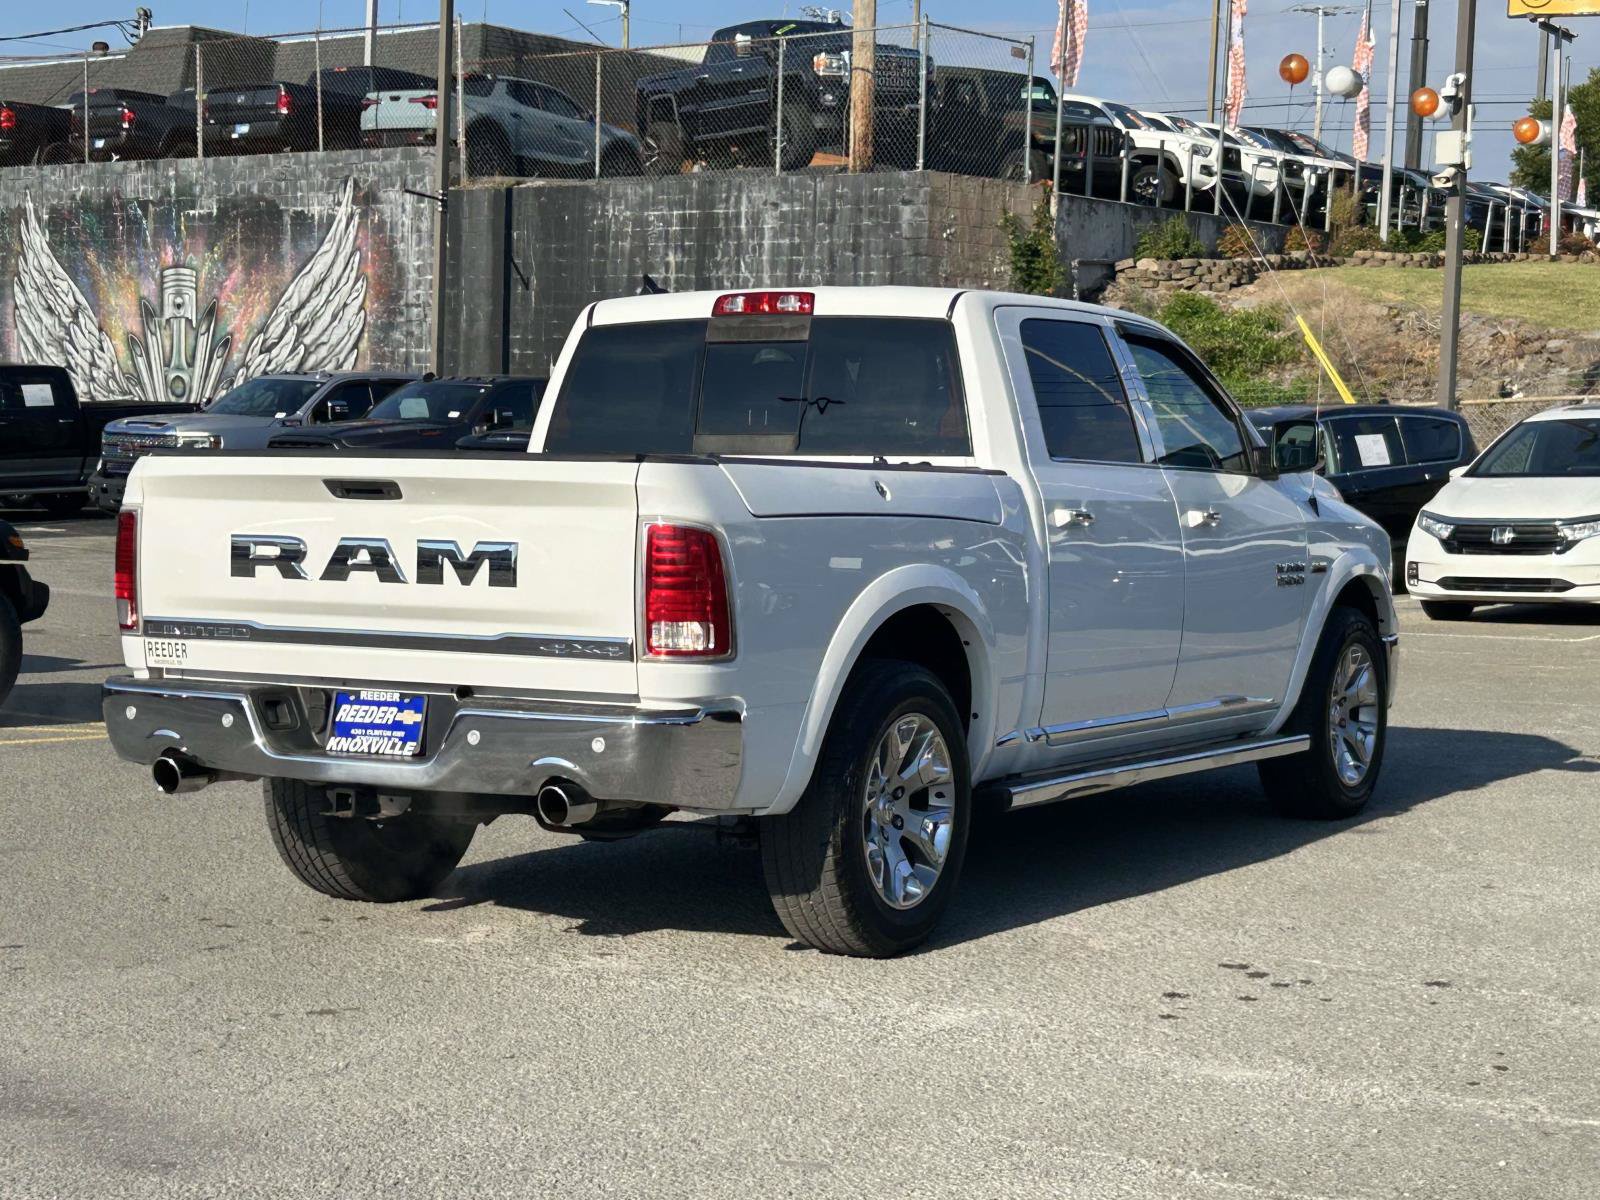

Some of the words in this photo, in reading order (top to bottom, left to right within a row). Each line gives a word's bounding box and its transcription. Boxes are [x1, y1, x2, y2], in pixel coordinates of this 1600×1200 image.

[231, 534, 519, 588] RAM
[148, 624, 250, 638] LIMITED
[147, 641, 188, 659] REEDER
[360, 690, 400, 702] REEDER
[335, 704, 398, 724] REEDER
[326, 736, 417, 756] KNOXVILLE
